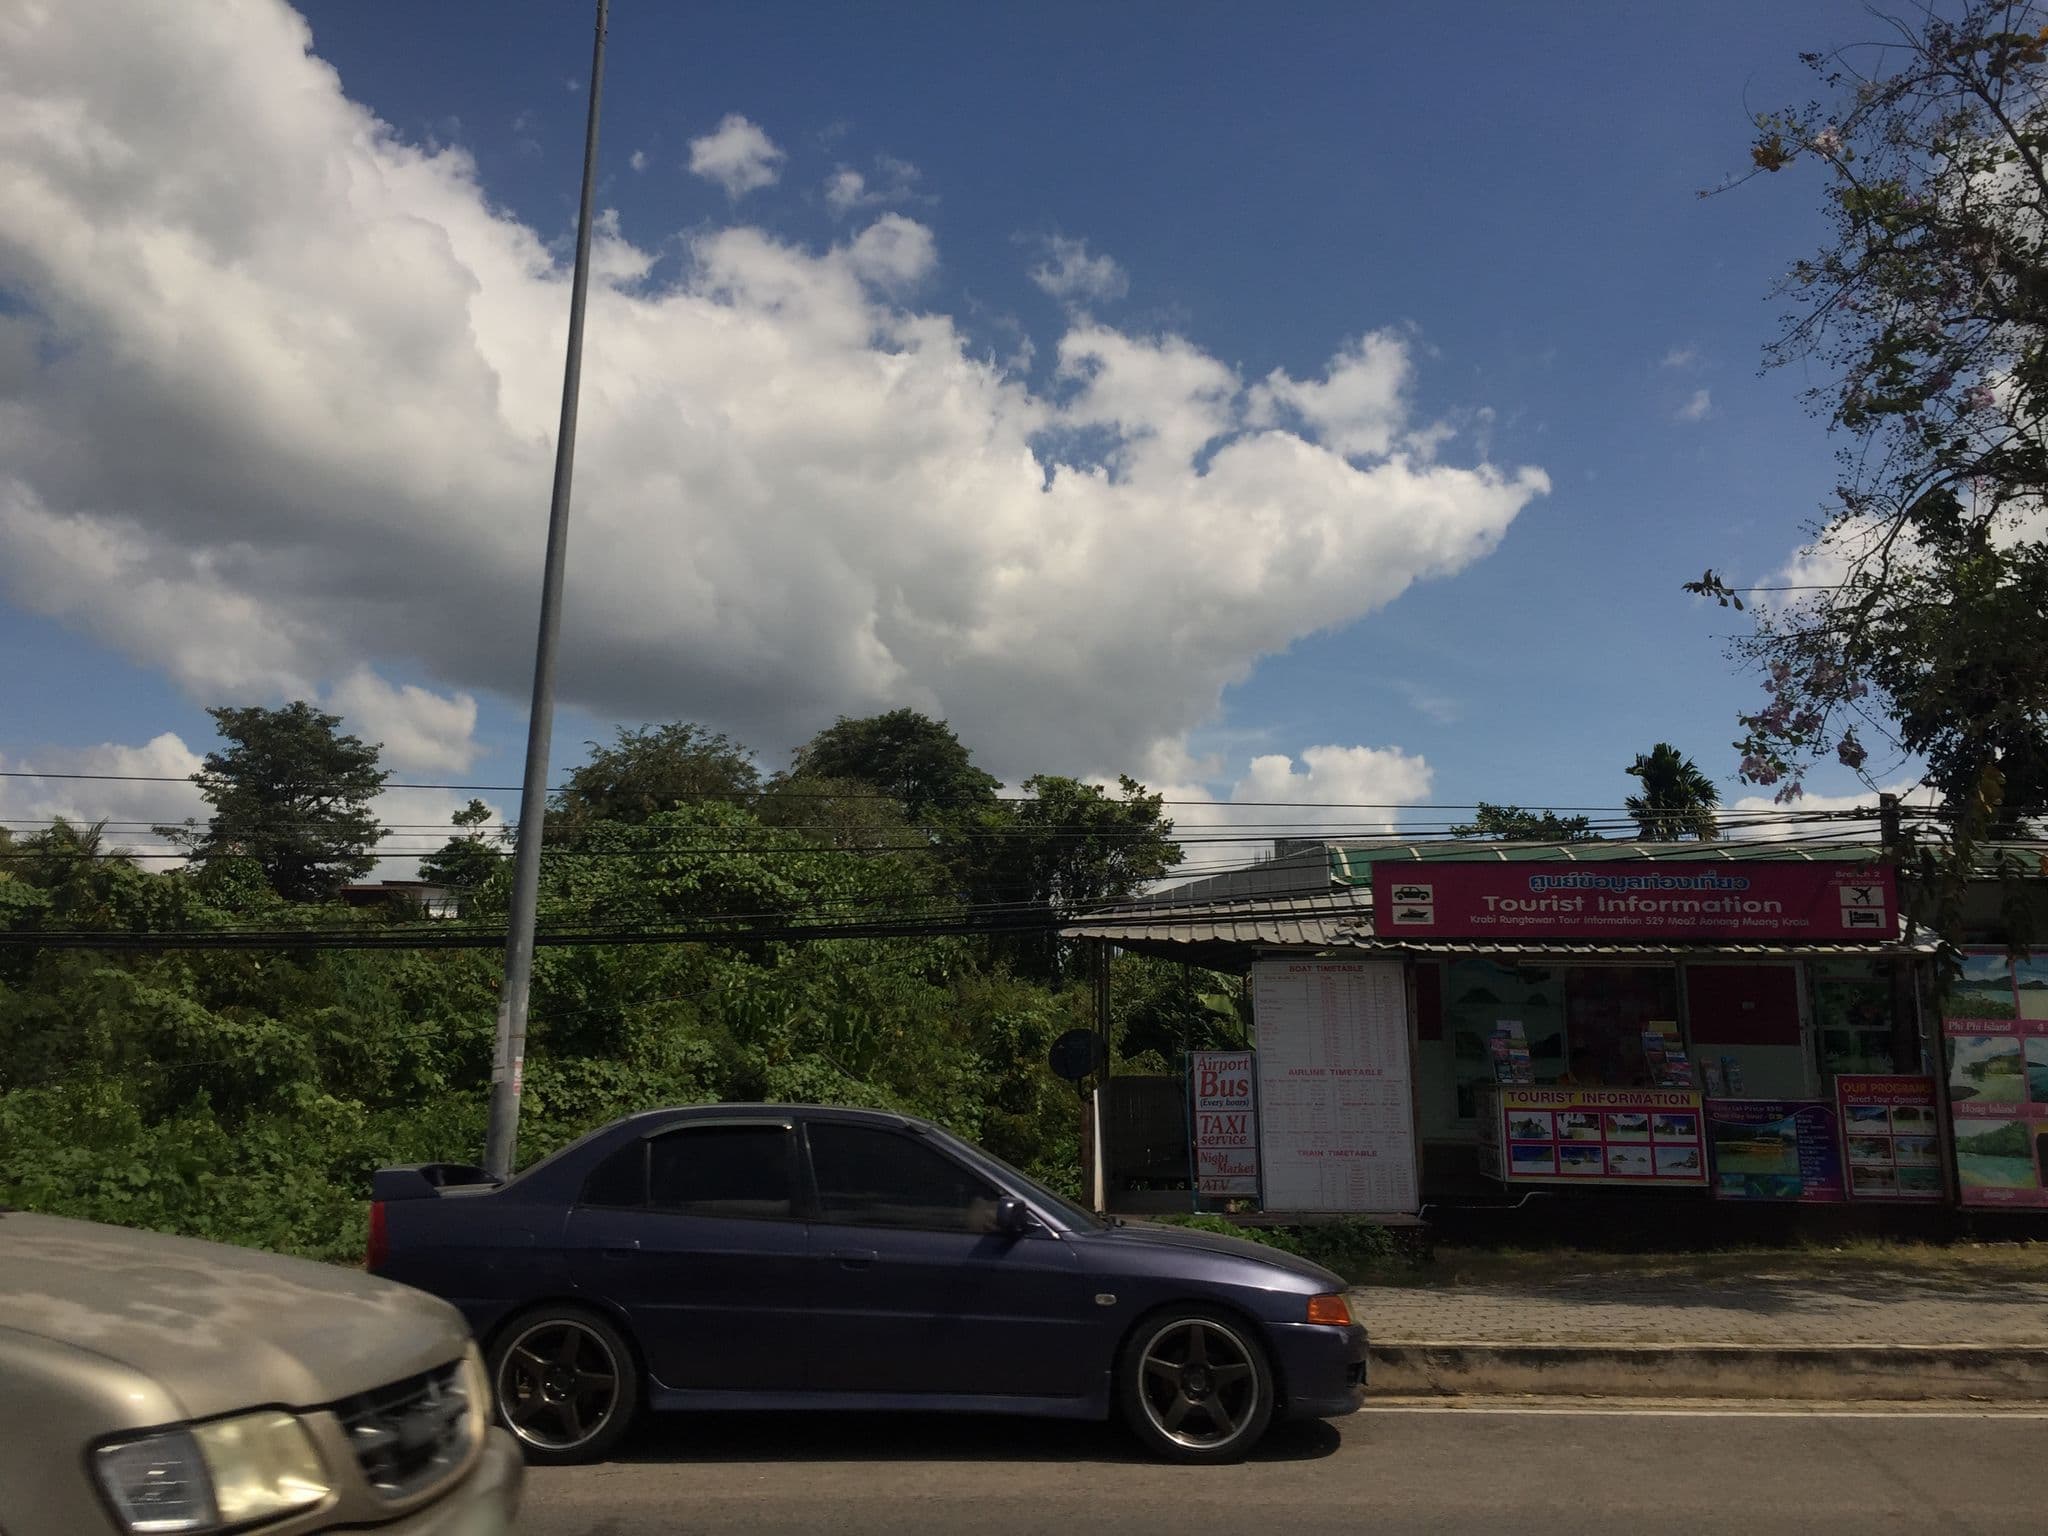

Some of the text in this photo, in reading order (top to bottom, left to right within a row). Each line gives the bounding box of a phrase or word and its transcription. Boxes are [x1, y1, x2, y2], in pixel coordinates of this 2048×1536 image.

[1835, 871, 1871, 879] Brach
[1482, 895, 1783, 913] Tourist Information
[1470, 914, 1497, 925] Krabi
[1558, 915, 1580, 925] Tour
[1583, 915, 1642, 926] Information
[1645, 916, 1664, 926] 529
[1289, 965, 1364, 973] BOAT TIMETABLE
[1984, 1021, 2012, 1031] Island
[1197, 1056, 1249, 1073] Airport
[1288, 1068, 1384, 1076] AIRLINE TIMETABLE
[1199, 1070, 1249, 1098] Bus
[1508, 1091, 1690, 1105] TOURIST INFORMATION
[1200, 1114, 1247, 1135] TAXI
[1200, 1135, 1247, 1146] service
[1200, 1151, 1228, 1166] Night
[1217, 1162, 1255, 1174] Market
